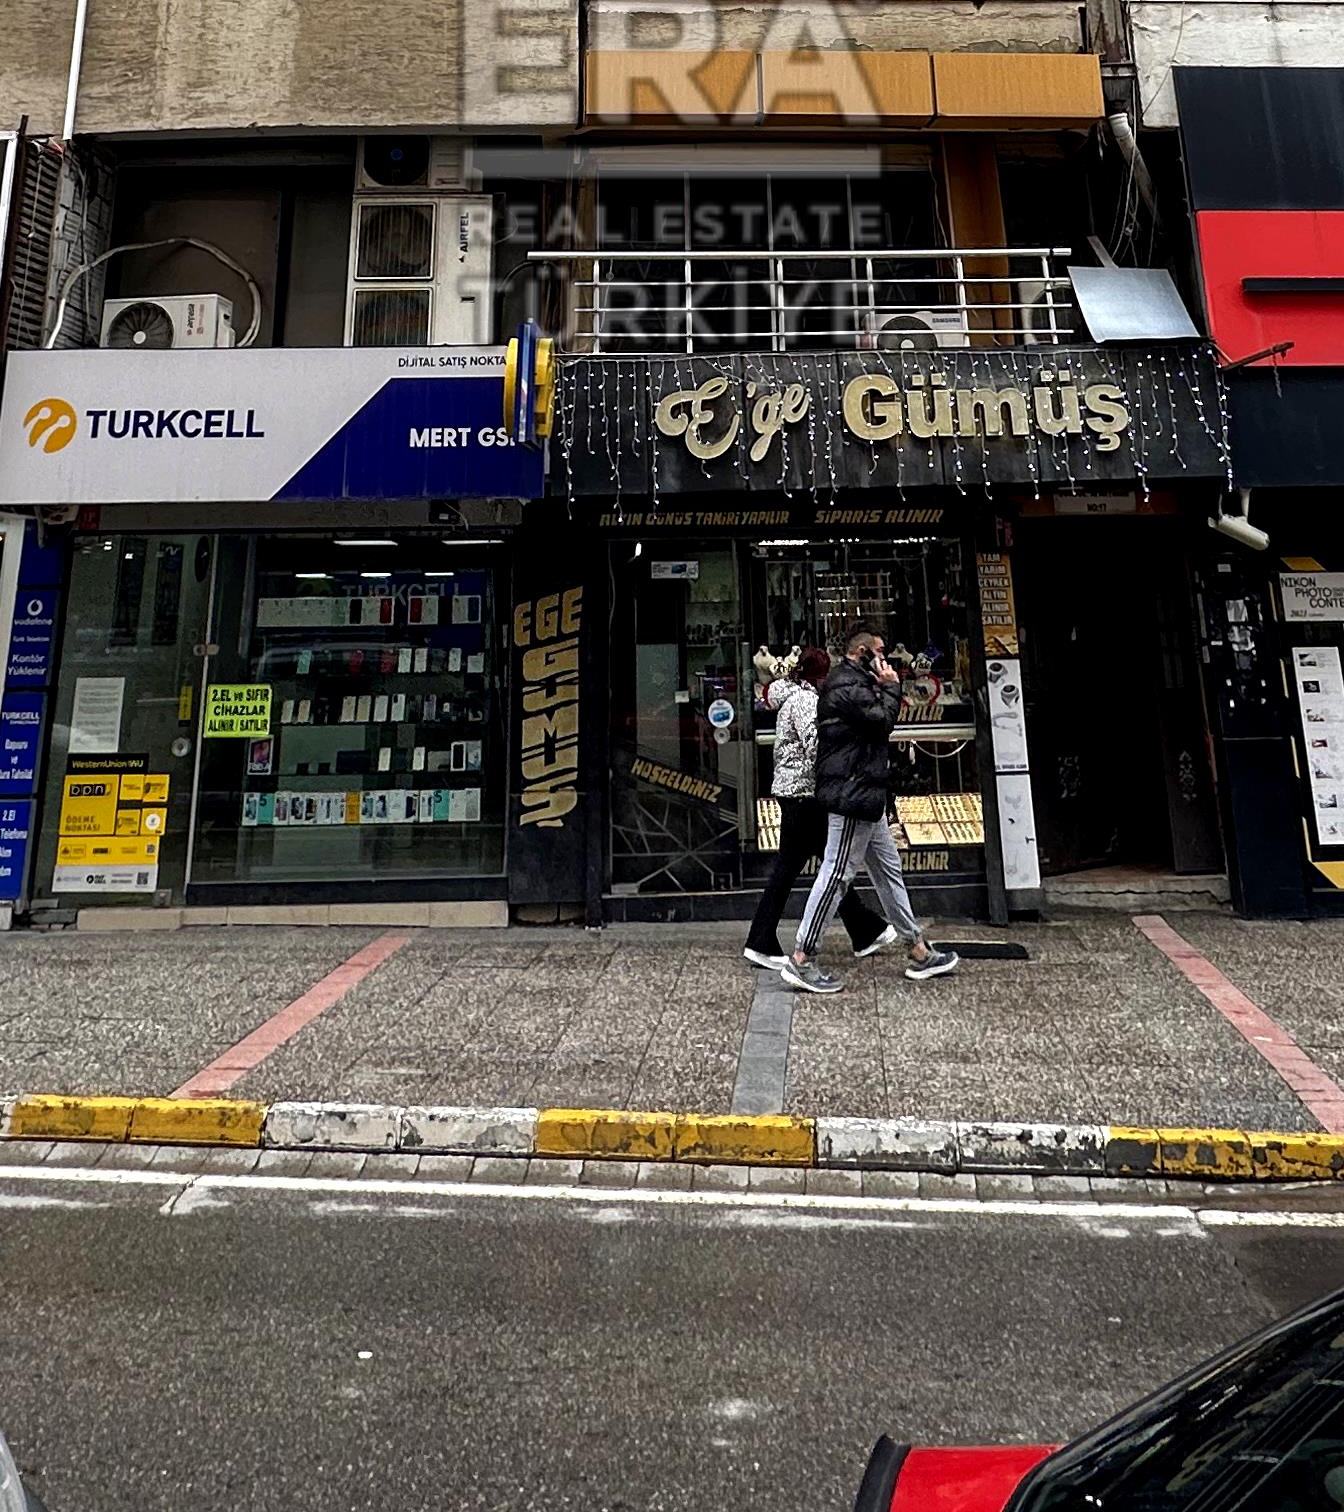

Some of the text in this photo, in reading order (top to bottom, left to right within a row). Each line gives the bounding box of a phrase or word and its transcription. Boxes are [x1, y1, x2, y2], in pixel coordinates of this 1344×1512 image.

[459, 212, 470, 253] AIRFEL
[397, 354, 507, 370] DİJİTAL SATIŞ NOKTA
[843, 368, 1130, 452] Gümüş
[85, 408, 265, 440] TURKCELL
[409, 427, 516, 449] MERT GS
[982, 553, 1001, 562] TAM
[979, 565, 1006, 575] YARIM
[1280, 576, 1317, 588] NIKON
[982, 590, 1007, 600] ALTIN
[1294, 587, 1333, 598] PHOTO
[982, 603, 1009, 613] ALINIR
[13, 618, 53, 626] vodafone
[513, 585, 584, 648] EGE
[981, 615, 1013, 625] SATILIR
[11, 654, 45, 664] Kontör
[7, 665, 47, 676] Yüklenir
[211, 689, 231, 702] 2.EL
[245, 688, 270, 702] SIFIR
[213, 703, 266, 716] CİHAZLAR
[897, 704, 945, 722] ATILIR
[1, 711, 41, 720] TURKCELL
[10, 756, 19, 765] ve
[65, 815, 96, 824] ÖDEME
